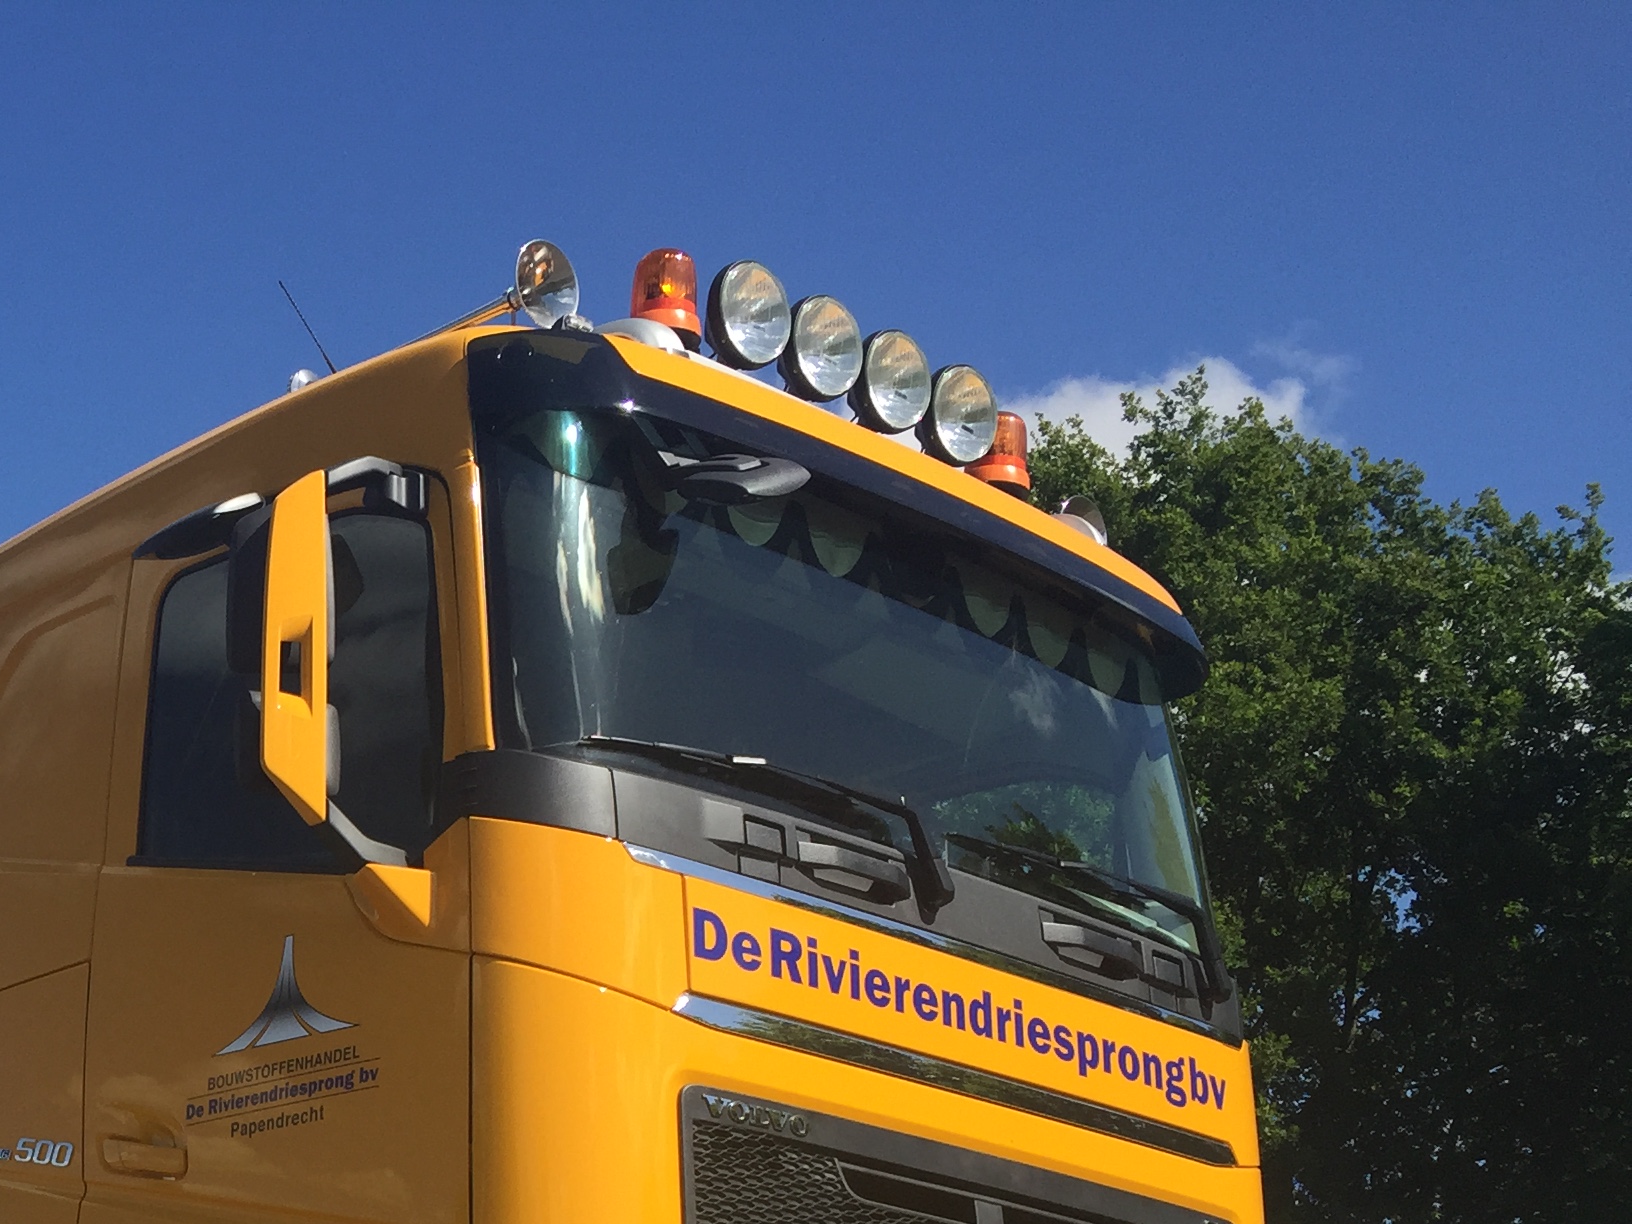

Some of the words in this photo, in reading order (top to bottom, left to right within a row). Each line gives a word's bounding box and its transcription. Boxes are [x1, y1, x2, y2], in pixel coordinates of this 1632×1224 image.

[693, 907, 762, 972] De
[207, 1045, 360, 1091] BOUWSTOFFENHANDEL
[186, 1103, 204, 1120] De
[208, 1070, 356, 1115] Rivierendriesprong
[359, 1066, 380, 1084] bv
[701, 1093, 809, 1138] VOLVO
[231, 1105, 324, 1138] Papendrecht
[14, 1137, 73, 1167] 500
